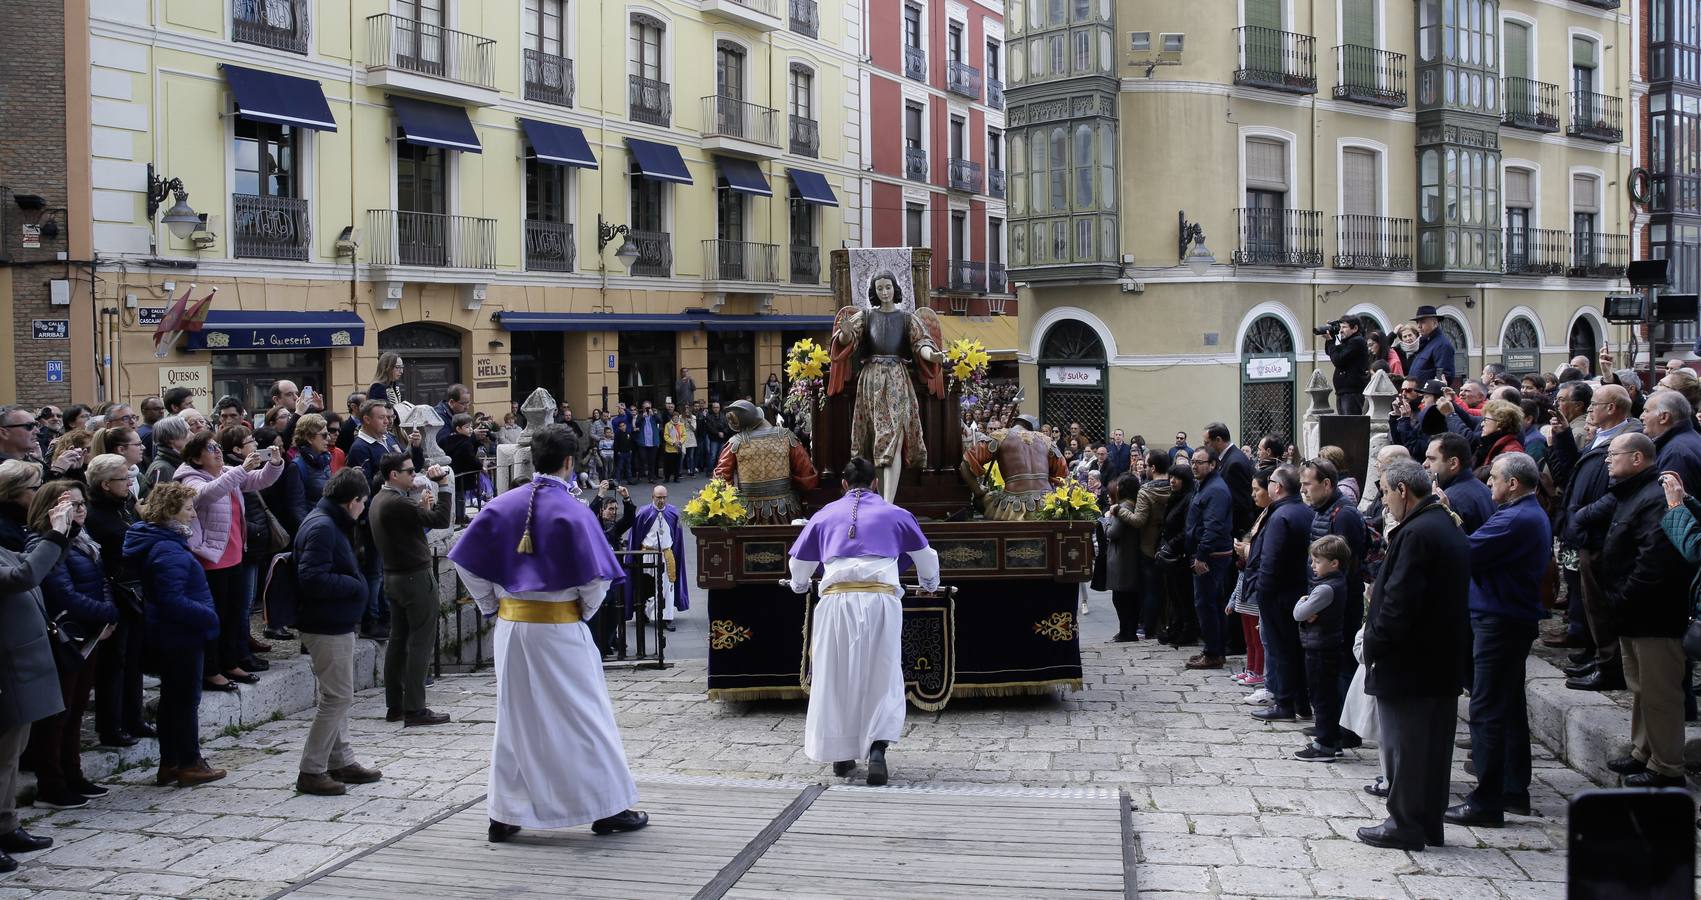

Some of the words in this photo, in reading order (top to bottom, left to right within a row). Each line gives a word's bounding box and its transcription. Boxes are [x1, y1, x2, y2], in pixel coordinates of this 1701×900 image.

[425, 310, 430, 319] 2
[252, 330, 265, 345] La
[48, 362, 61, 372] BM
[477, 358, 491, 366] NYC
[167, 369, 200, 385] QUESOS
[1067, 371, 1089, 381] suika
